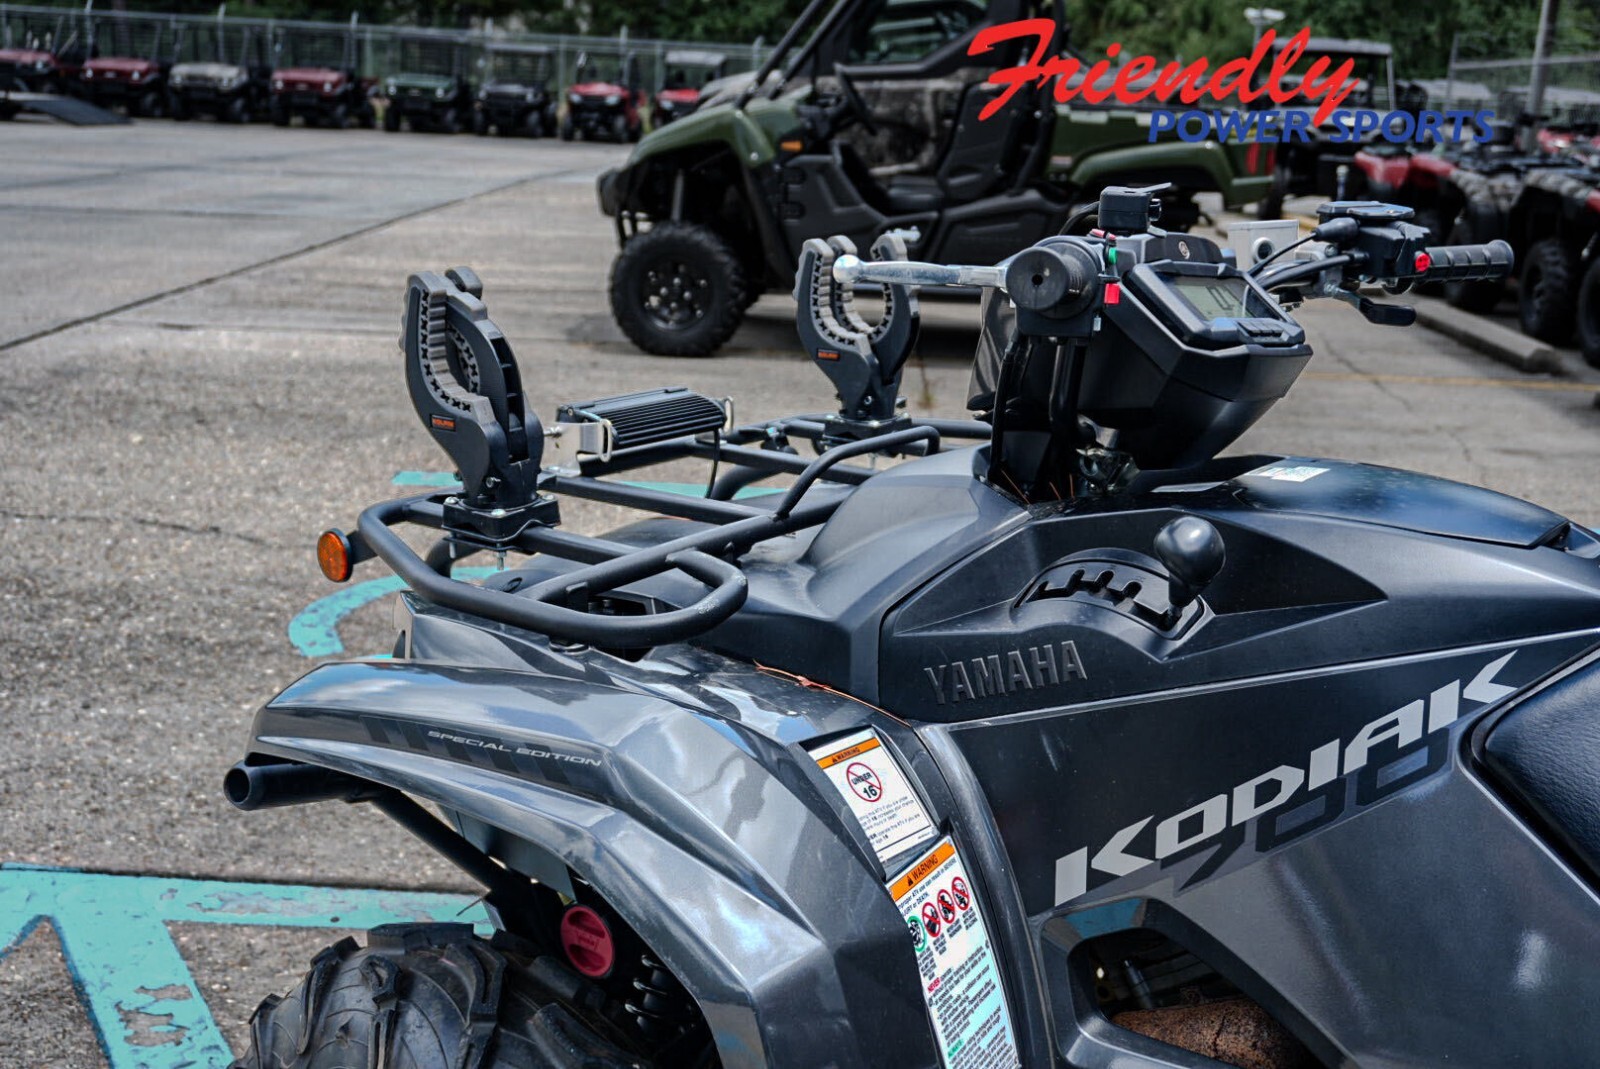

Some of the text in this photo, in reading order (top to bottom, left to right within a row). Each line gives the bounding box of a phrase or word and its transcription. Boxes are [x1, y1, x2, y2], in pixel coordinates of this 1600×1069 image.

[923, 640, 1088, 704] YAMAHA
[427, 730, 602, 767] SPECIAL EDITION
[837, 747, 860, 760] WARNING
[851, 772, 873, 785] UNDER
[1055, 650, 1517, 906] KODIAK
[863, 785, 878, 799] 16
[911, 854, 938, 880] WARNING
